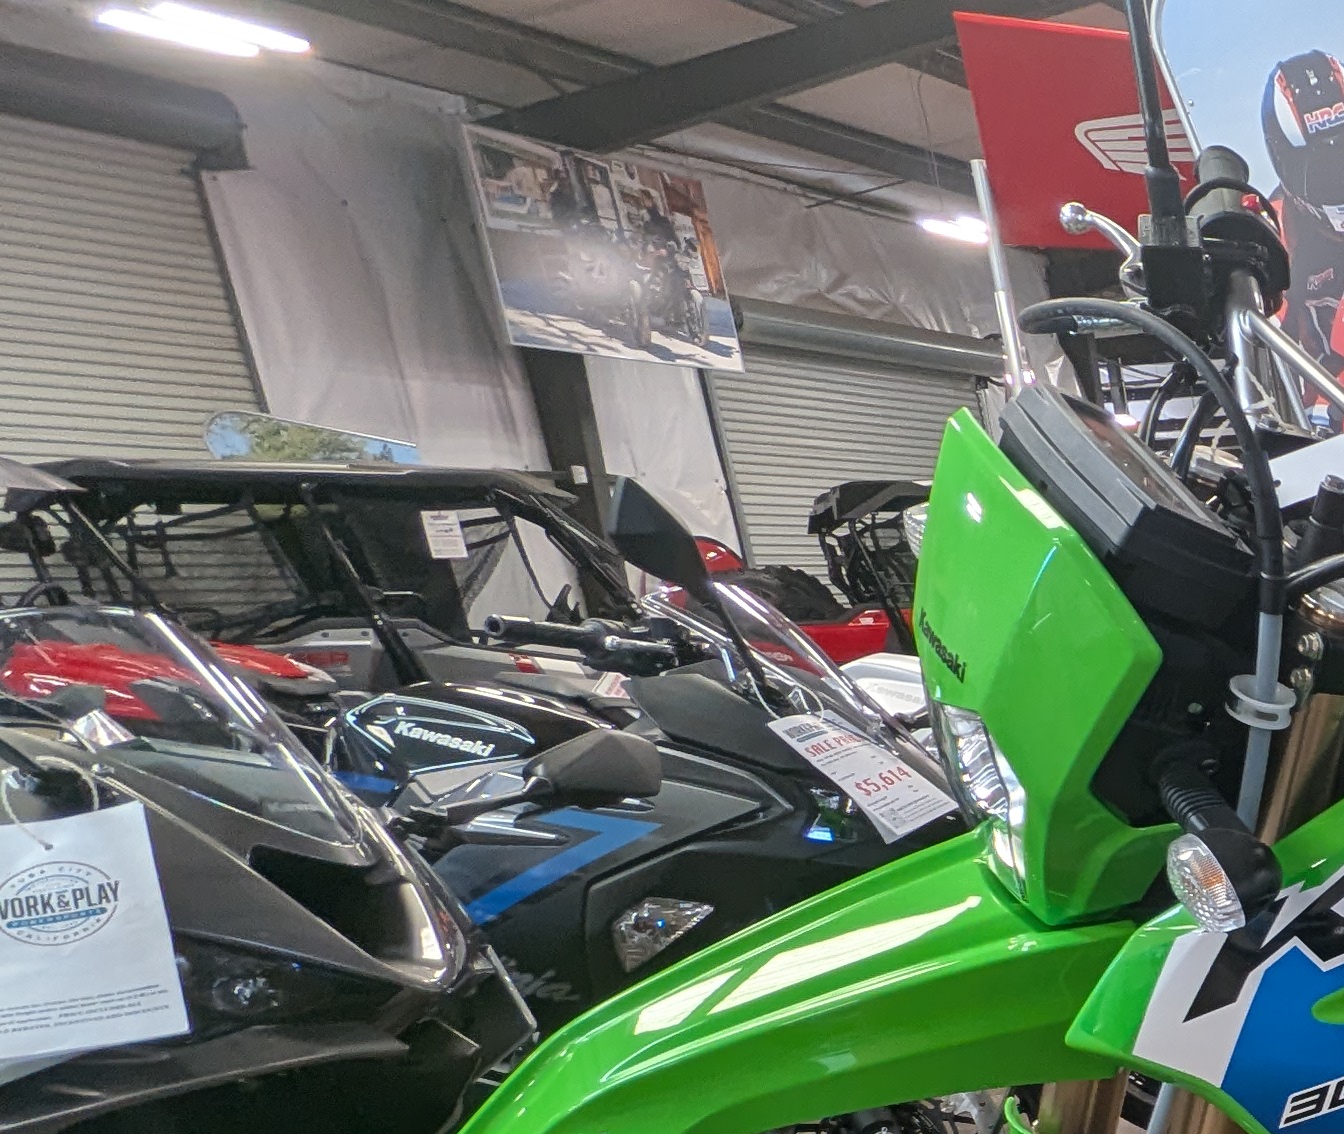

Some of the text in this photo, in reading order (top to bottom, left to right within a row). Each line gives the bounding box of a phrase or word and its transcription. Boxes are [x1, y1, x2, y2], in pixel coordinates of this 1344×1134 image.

[918, 606, 967, 684] Kawasaki
[394, 720, 496, 758] Kawasaki
[804, 738, 838, 758] SALE
[832, 733, 867, 750] PRIC
[854, 765, 912, 797] $5,614
